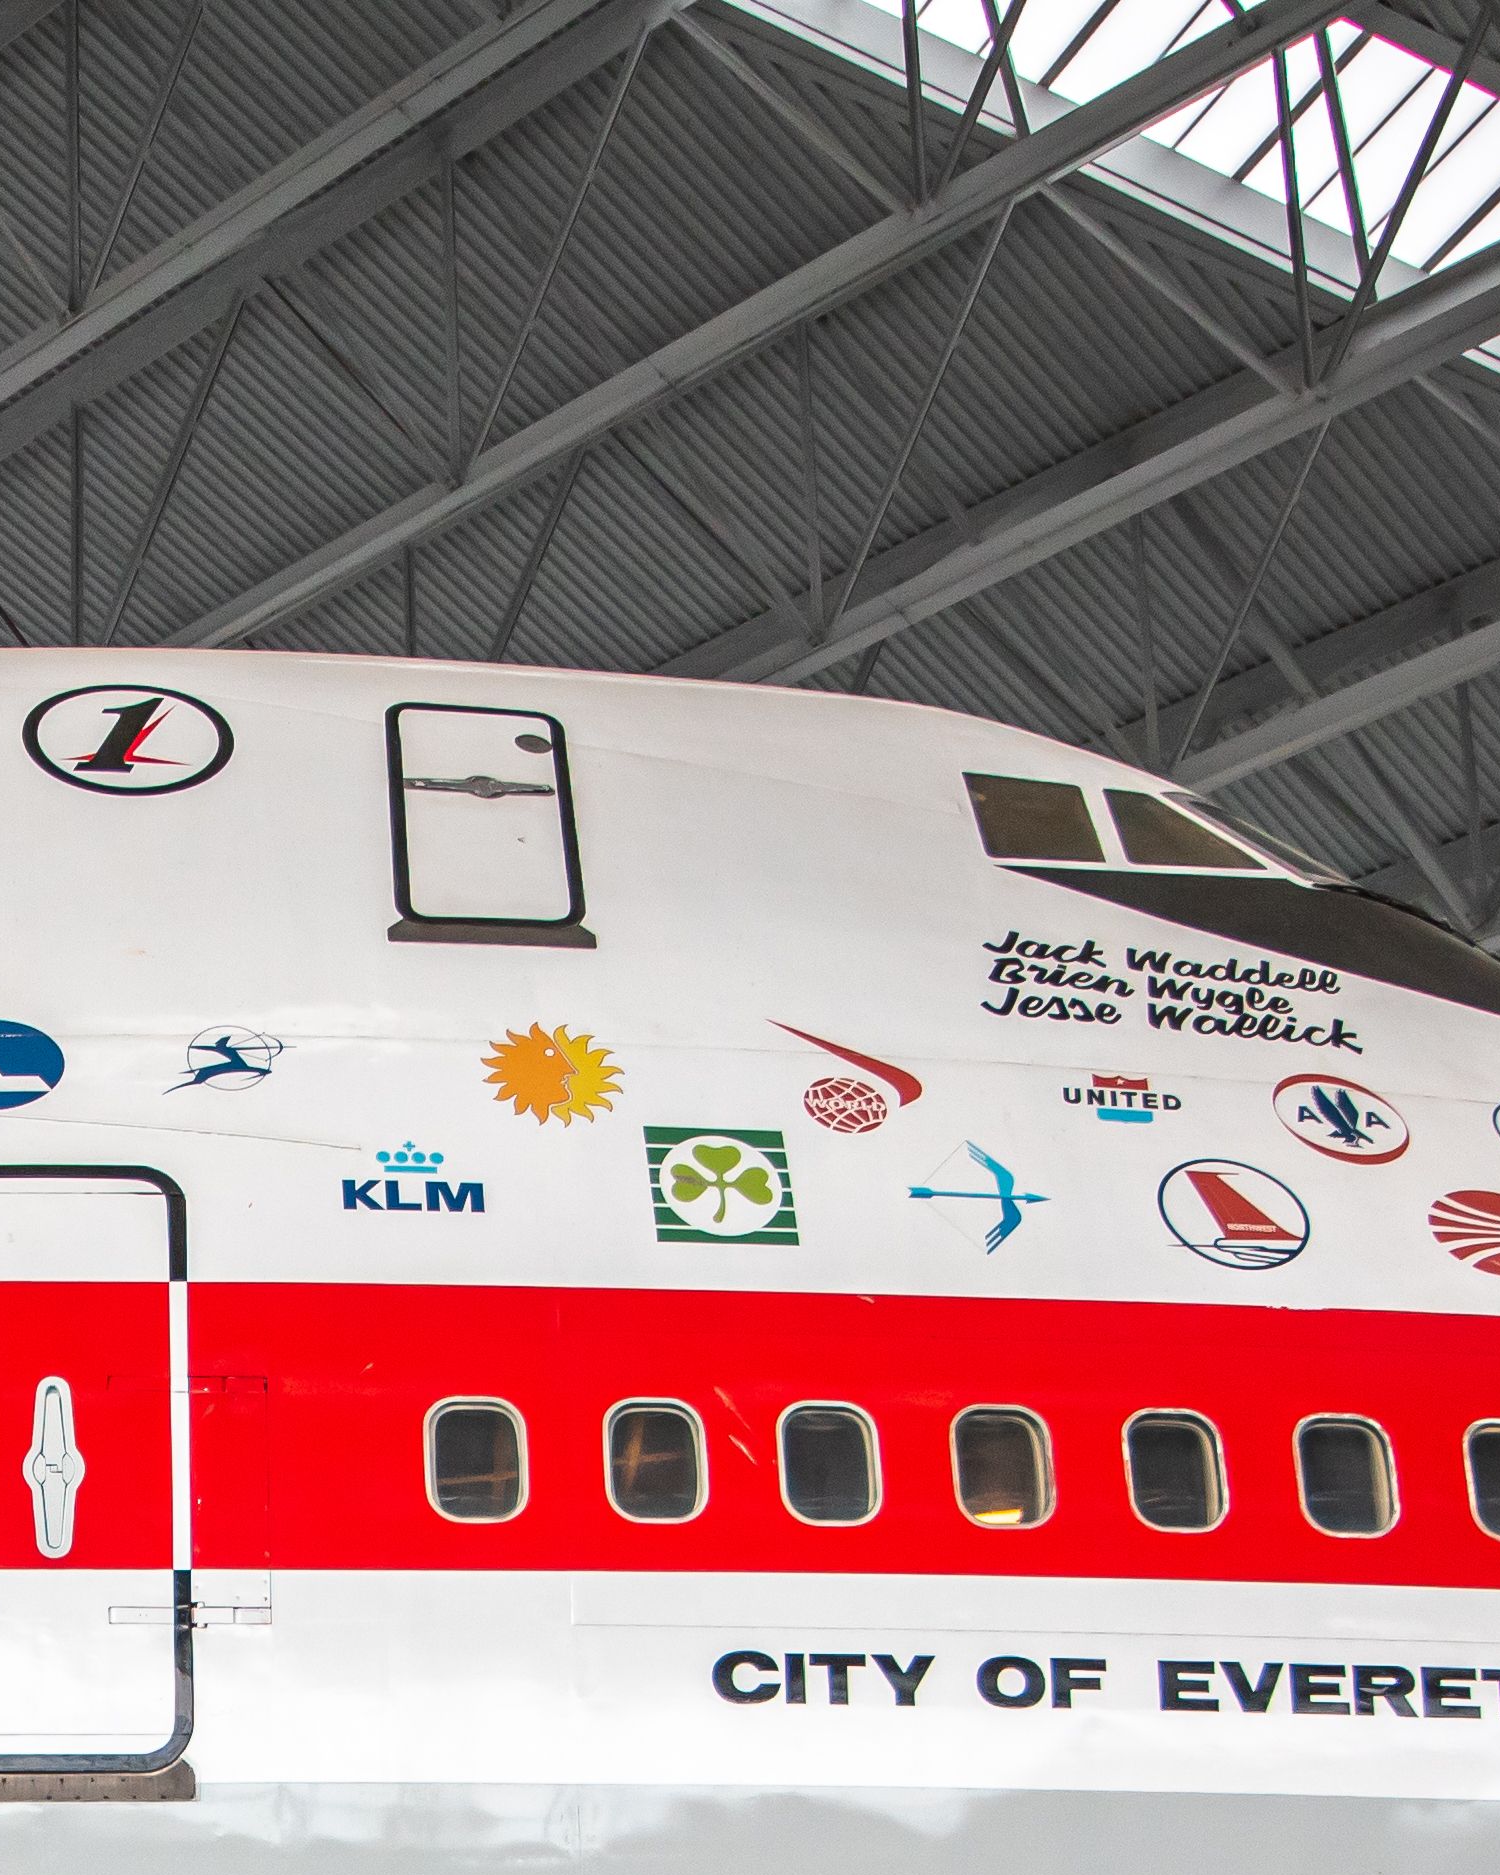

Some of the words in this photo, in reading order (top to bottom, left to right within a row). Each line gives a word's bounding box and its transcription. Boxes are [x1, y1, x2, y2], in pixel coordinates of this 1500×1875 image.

[982, 930, 1107, 968] Jack
[1126, 947, 1342, 995] Waddell
[987, 957, 1134, 998] Brien
[1146, 975, 1294, 1017] Wygle
[980, 987, 1122, 1025] Jesse
[1147, 1003, 1364, 1055] Wallick
[804, 1098, 886, 1112] WORLD
[1062, 1086, 1182, 1111] UNITED
[1297, 1105, 1323, 1126] A
[1365, 1108, 1391, 1129] A
[341, 1178, 485, 1213] KLM
[711, 1649, 936, 1707] CITY
[975, 1655, 1107, 1710] OF
